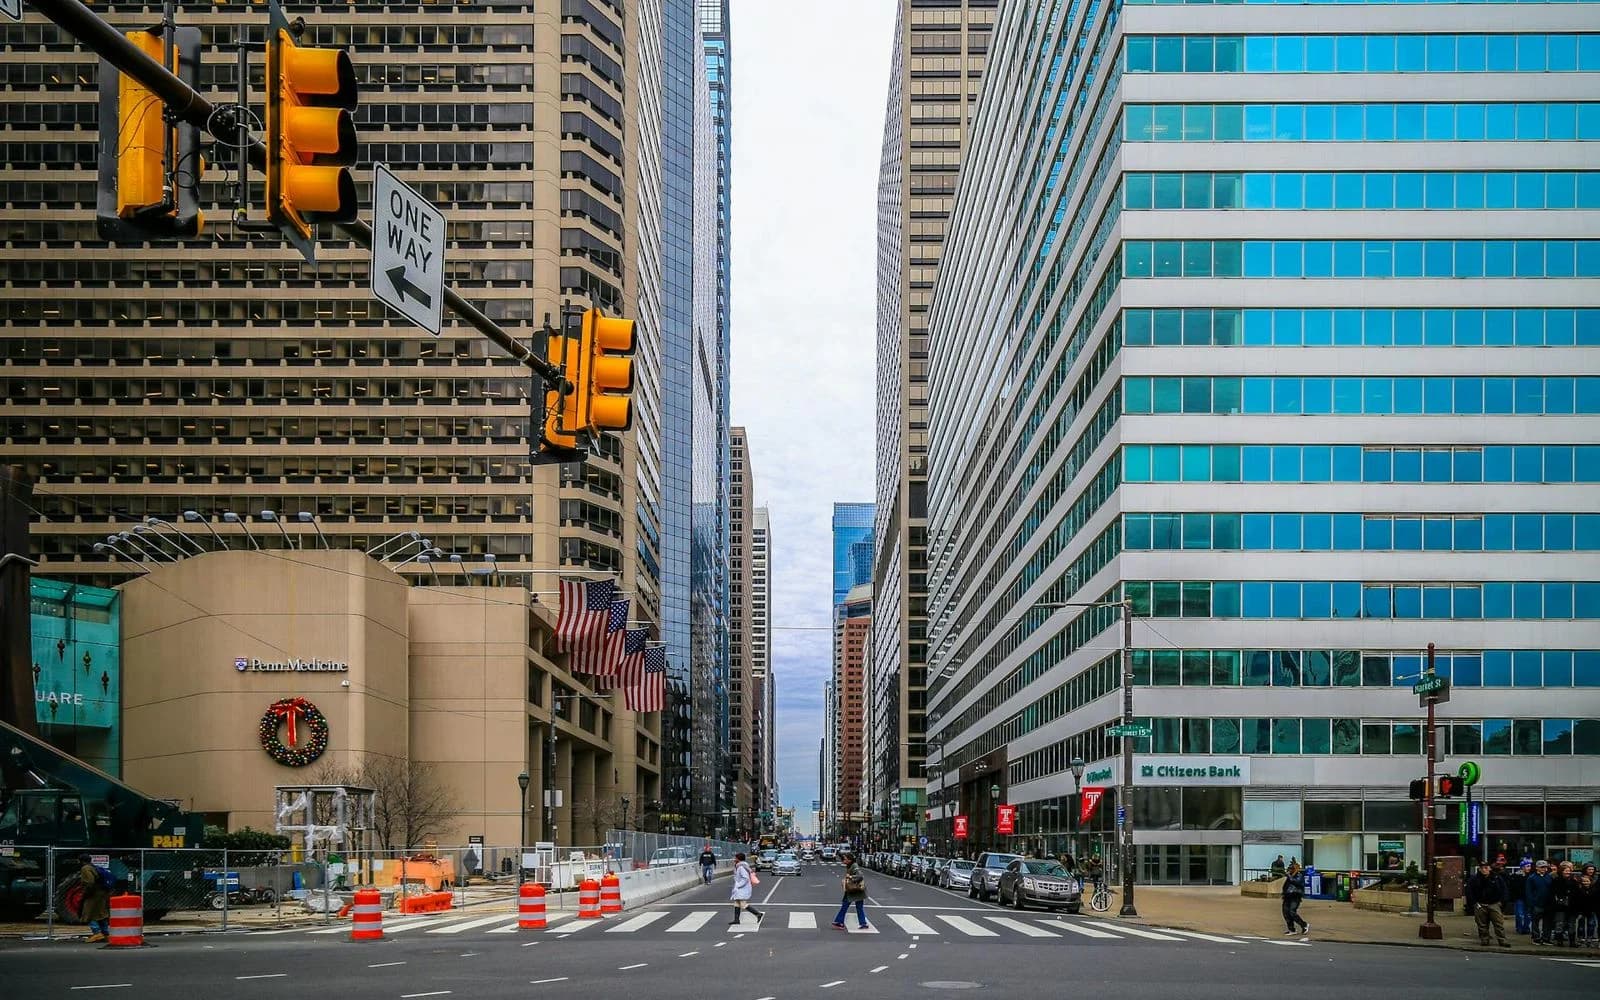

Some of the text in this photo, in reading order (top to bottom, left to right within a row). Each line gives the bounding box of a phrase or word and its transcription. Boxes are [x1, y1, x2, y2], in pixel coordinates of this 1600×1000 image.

[390, 189, 432, 243] ONE
[387, 220, 433, 274] WAY
[252, 657, 348, 672] Penn Medicine
[1156, 765, 1241, 777] Citizens Bank
[152, 835, 185, 848] P&H
